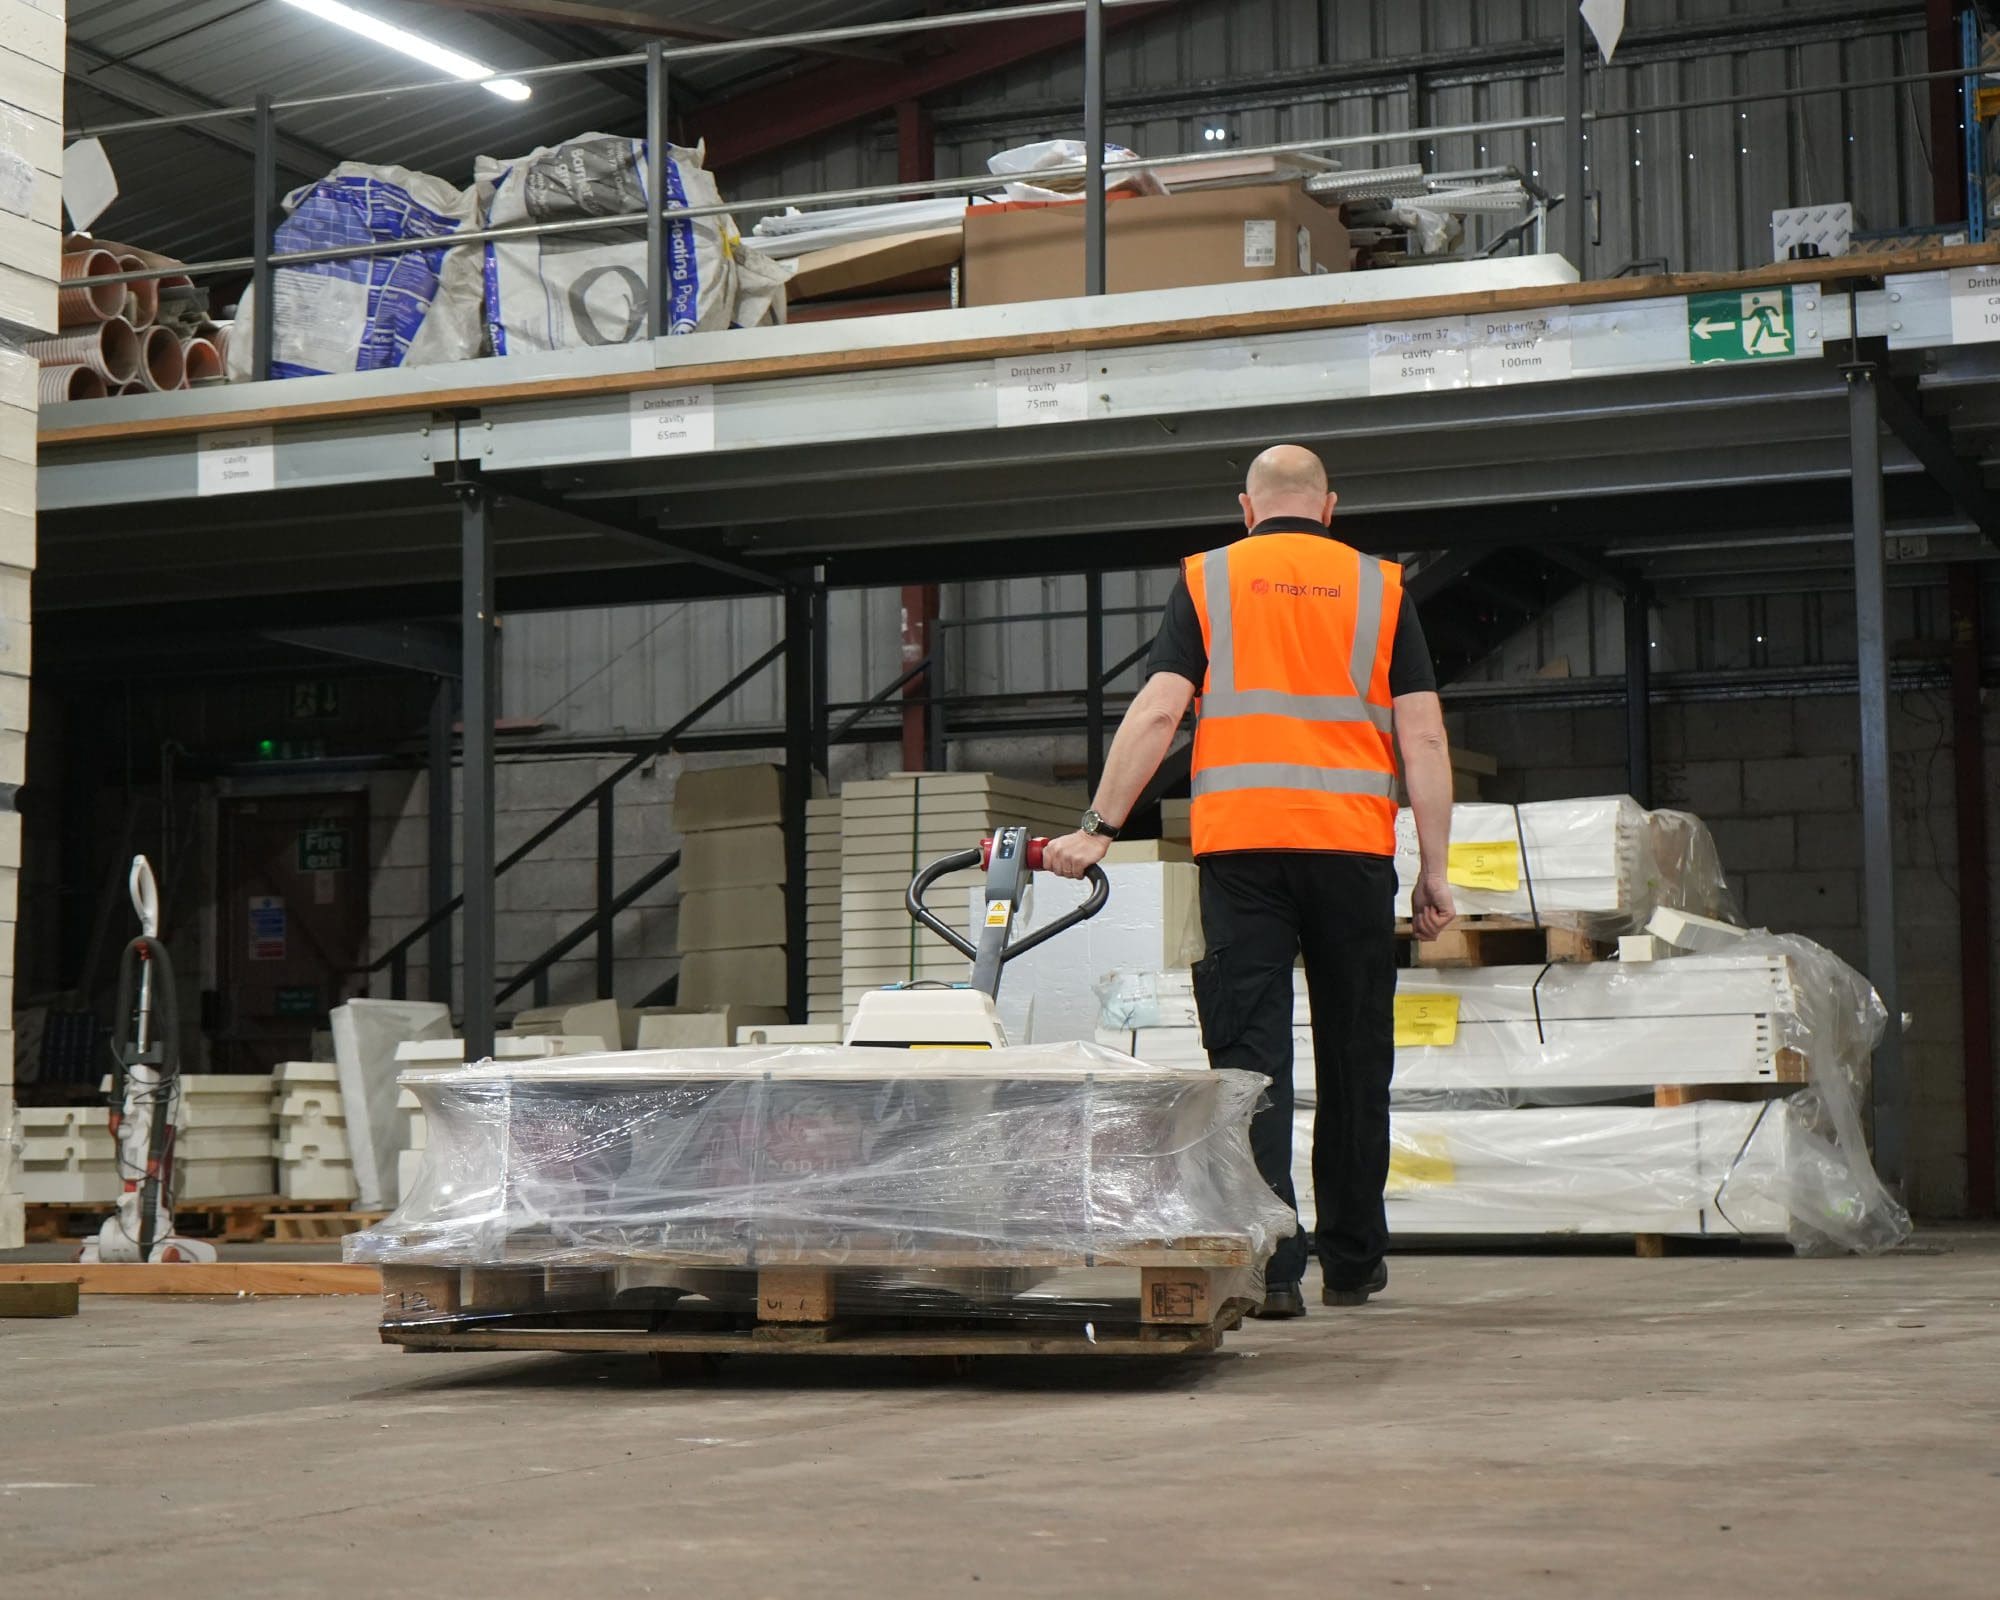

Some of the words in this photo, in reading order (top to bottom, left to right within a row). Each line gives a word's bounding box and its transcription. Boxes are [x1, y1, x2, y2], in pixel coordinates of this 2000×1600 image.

[675, 284, 693, 313] Pipe
[1435, 328, 1449, 340] 37
[1505, 338, 1537, 350] cavity
[1402, 349, 1433, 360] cavity
[1501, 357, 1542, 368] 100mm
[1011, 364, 1056, 377] Dritherm
[1059, 362, 1072, 373] 37
[1401, 366, 1435, 377] 85mm
[1028, 382, 1056, 392] cavity
[1026, 399, 1058, 409] 75mm
[659, 414, 685, 424] cavity
[657, 431, 687, 440] 65mm
[1274, 583, 1341, 598] maxmal
[1476, 855, 1485, 868] 5
